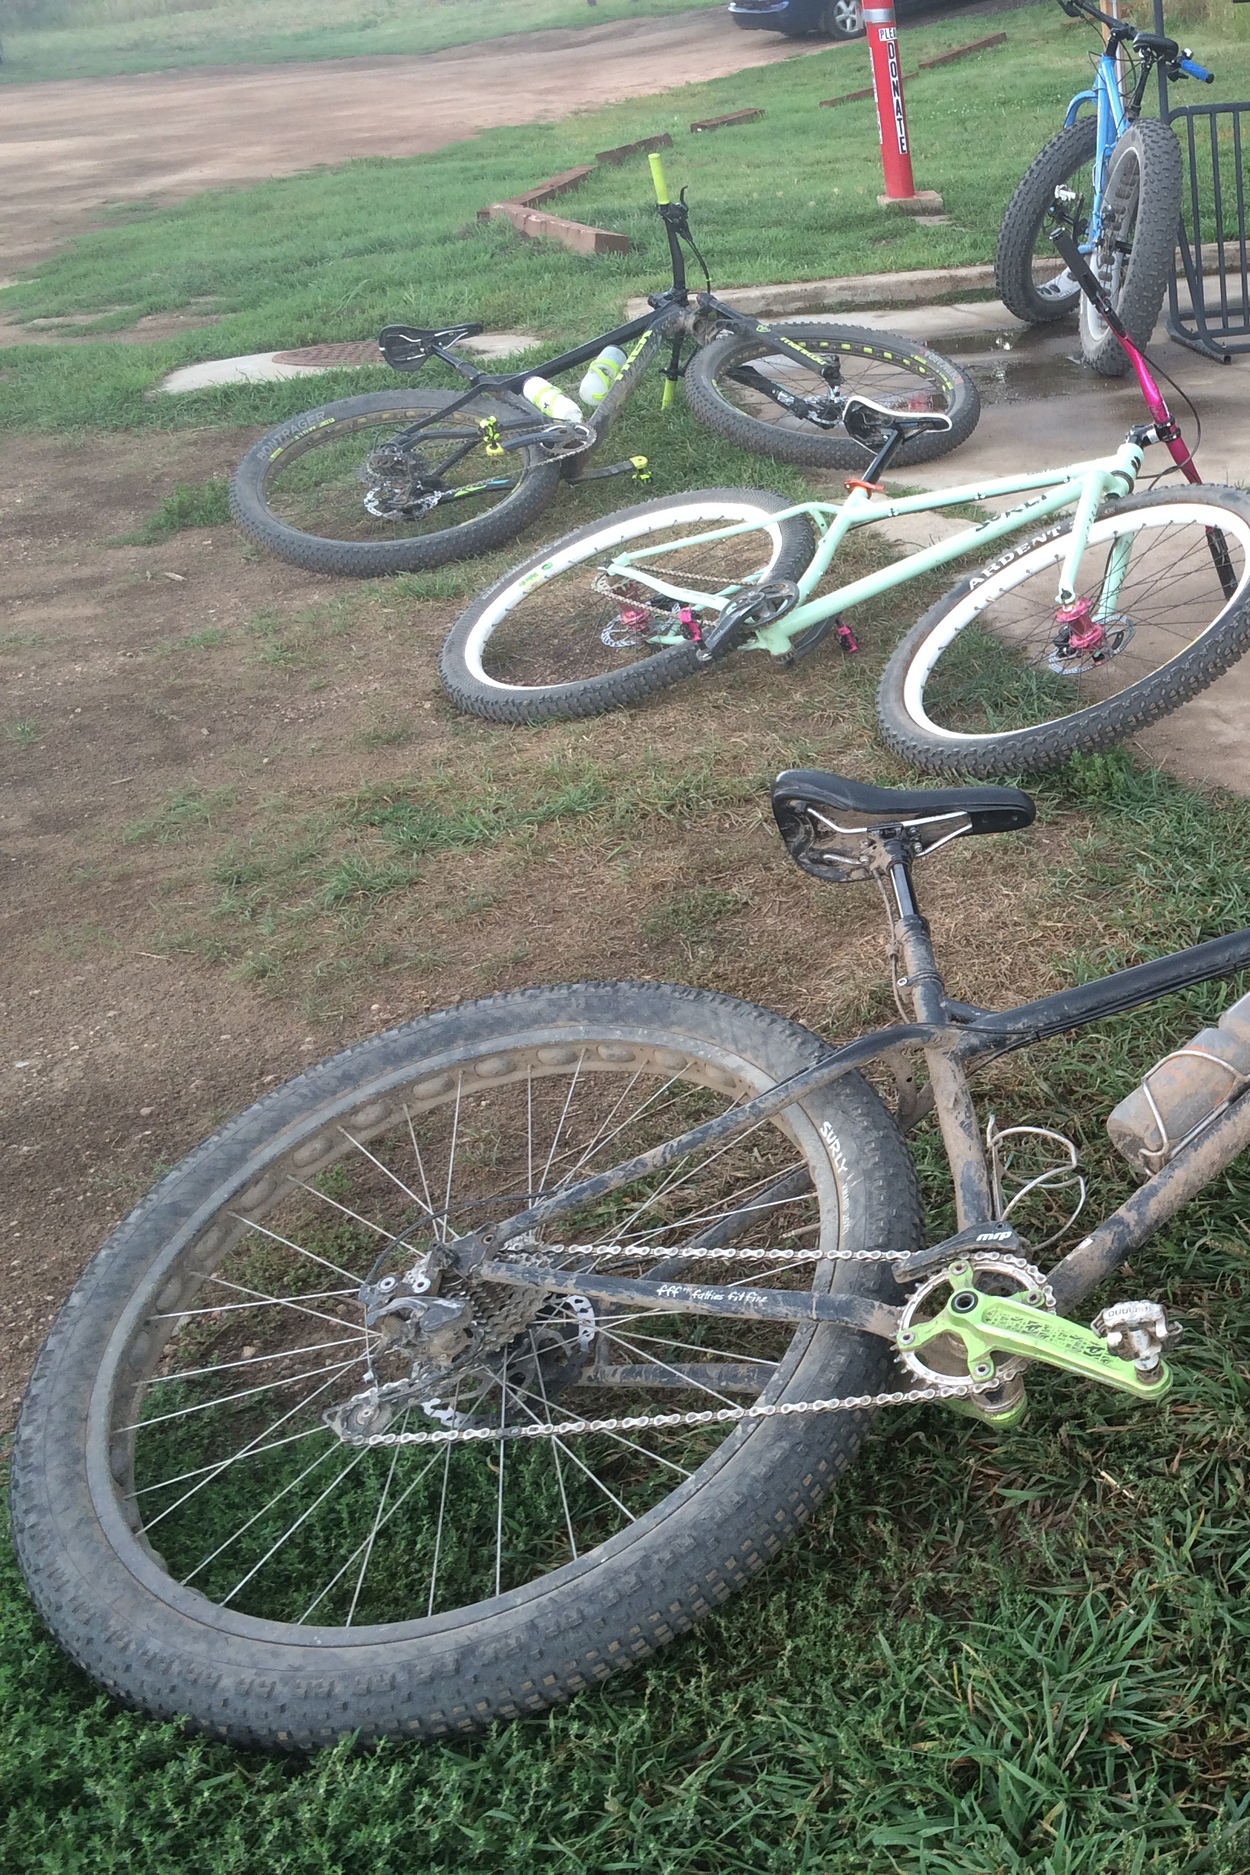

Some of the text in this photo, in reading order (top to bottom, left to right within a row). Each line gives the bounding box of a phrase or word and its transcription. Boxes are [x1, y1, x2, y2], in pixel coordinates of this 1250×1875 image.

[880, 28, 897, 40] PLEA
[888, 42, 907, 153] DONATE
[256, 411, 326, 461] BONTRAGER
[969, 525, 1062, 590] ARDENT
[820, 1121, 849, 1174] SURLY
[976, 1231, 1012, 1242] mrp
